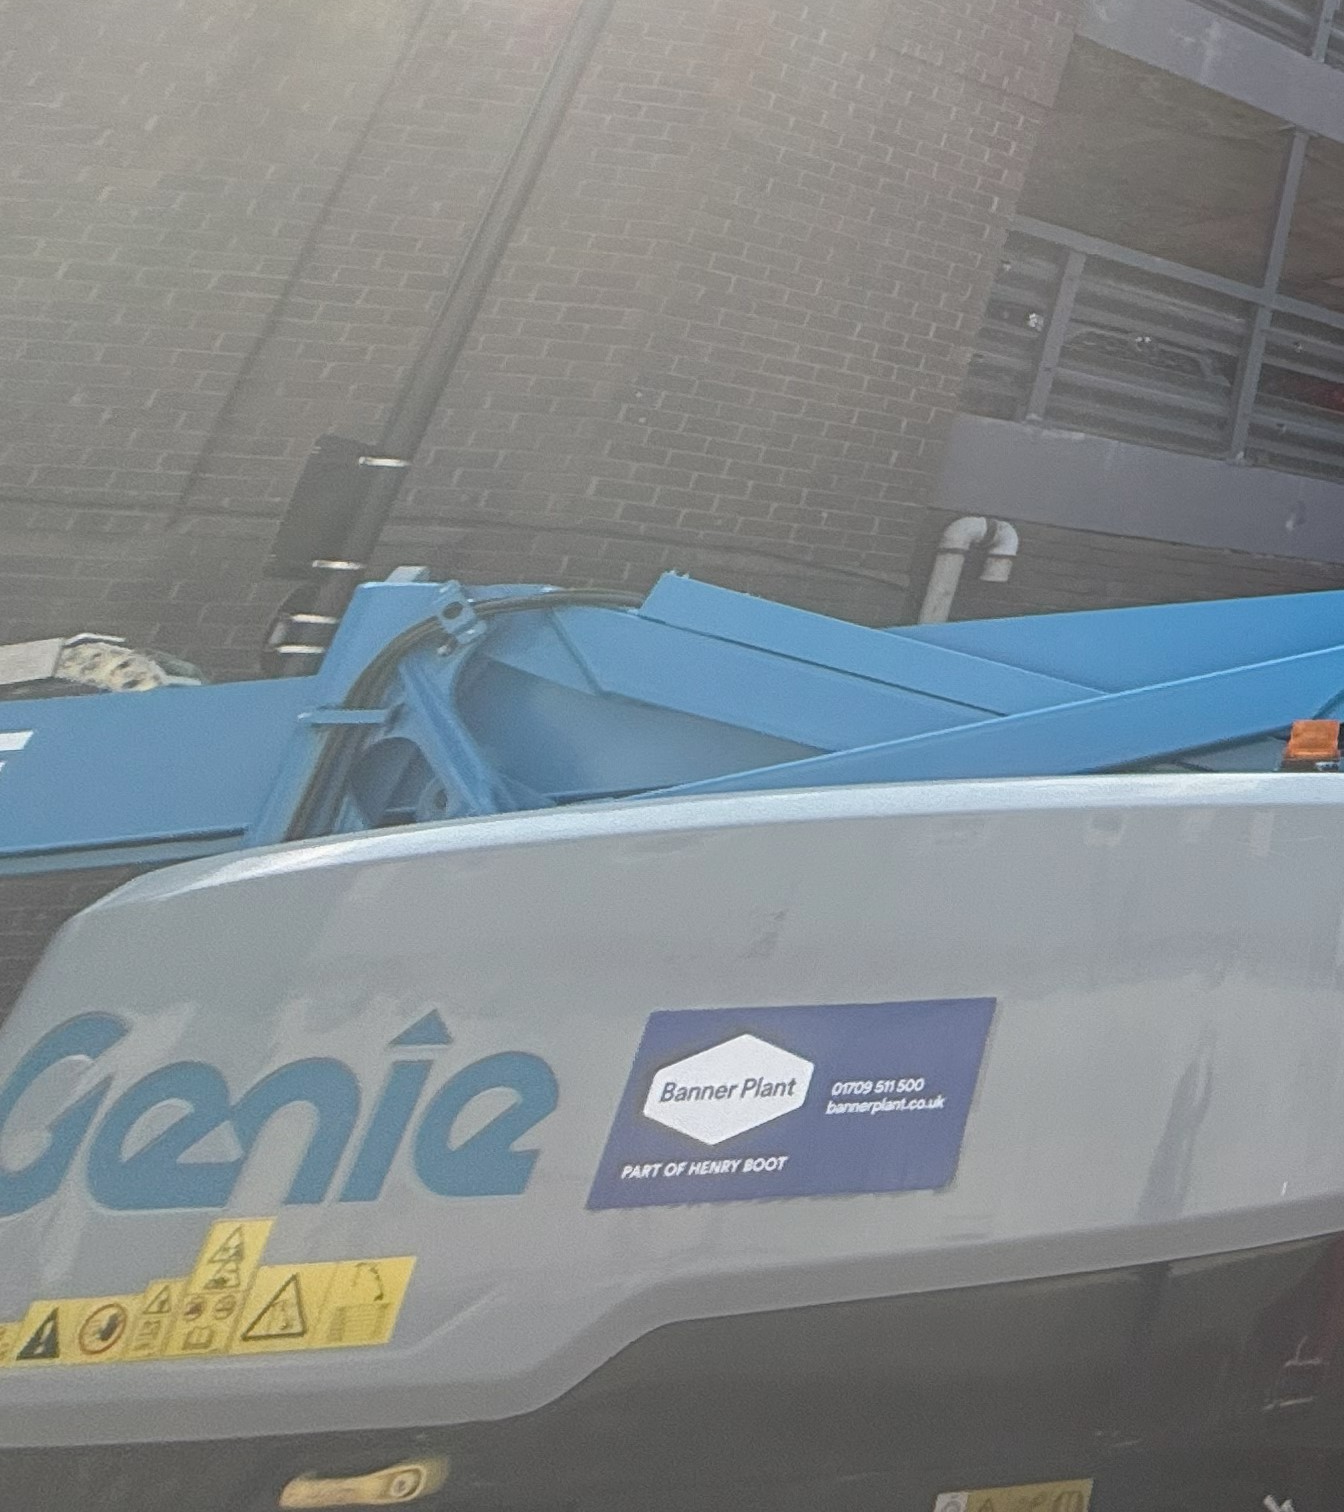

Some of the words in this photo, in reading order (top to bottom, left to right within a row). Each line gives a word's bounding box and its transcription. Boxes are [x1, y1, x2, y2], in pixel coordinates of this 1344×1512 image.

[660, 1082, 738, 1102] Banner
[740, 1077, 796, 1099] Plant
[831, 1081, 873, 1096] 01709
[874, 1079, 896, 1094] 511
[896, 1078, 925, 1093] 500
[825, 1094, 945, 1115] bannerplant.co.uk
[621, 1164, 663, 1179] PART
[663, 1161, 687, 1177] OF
[688, 1159, 742, 1176] HENRY
[742, 1156, 789, 1173] BOOT
